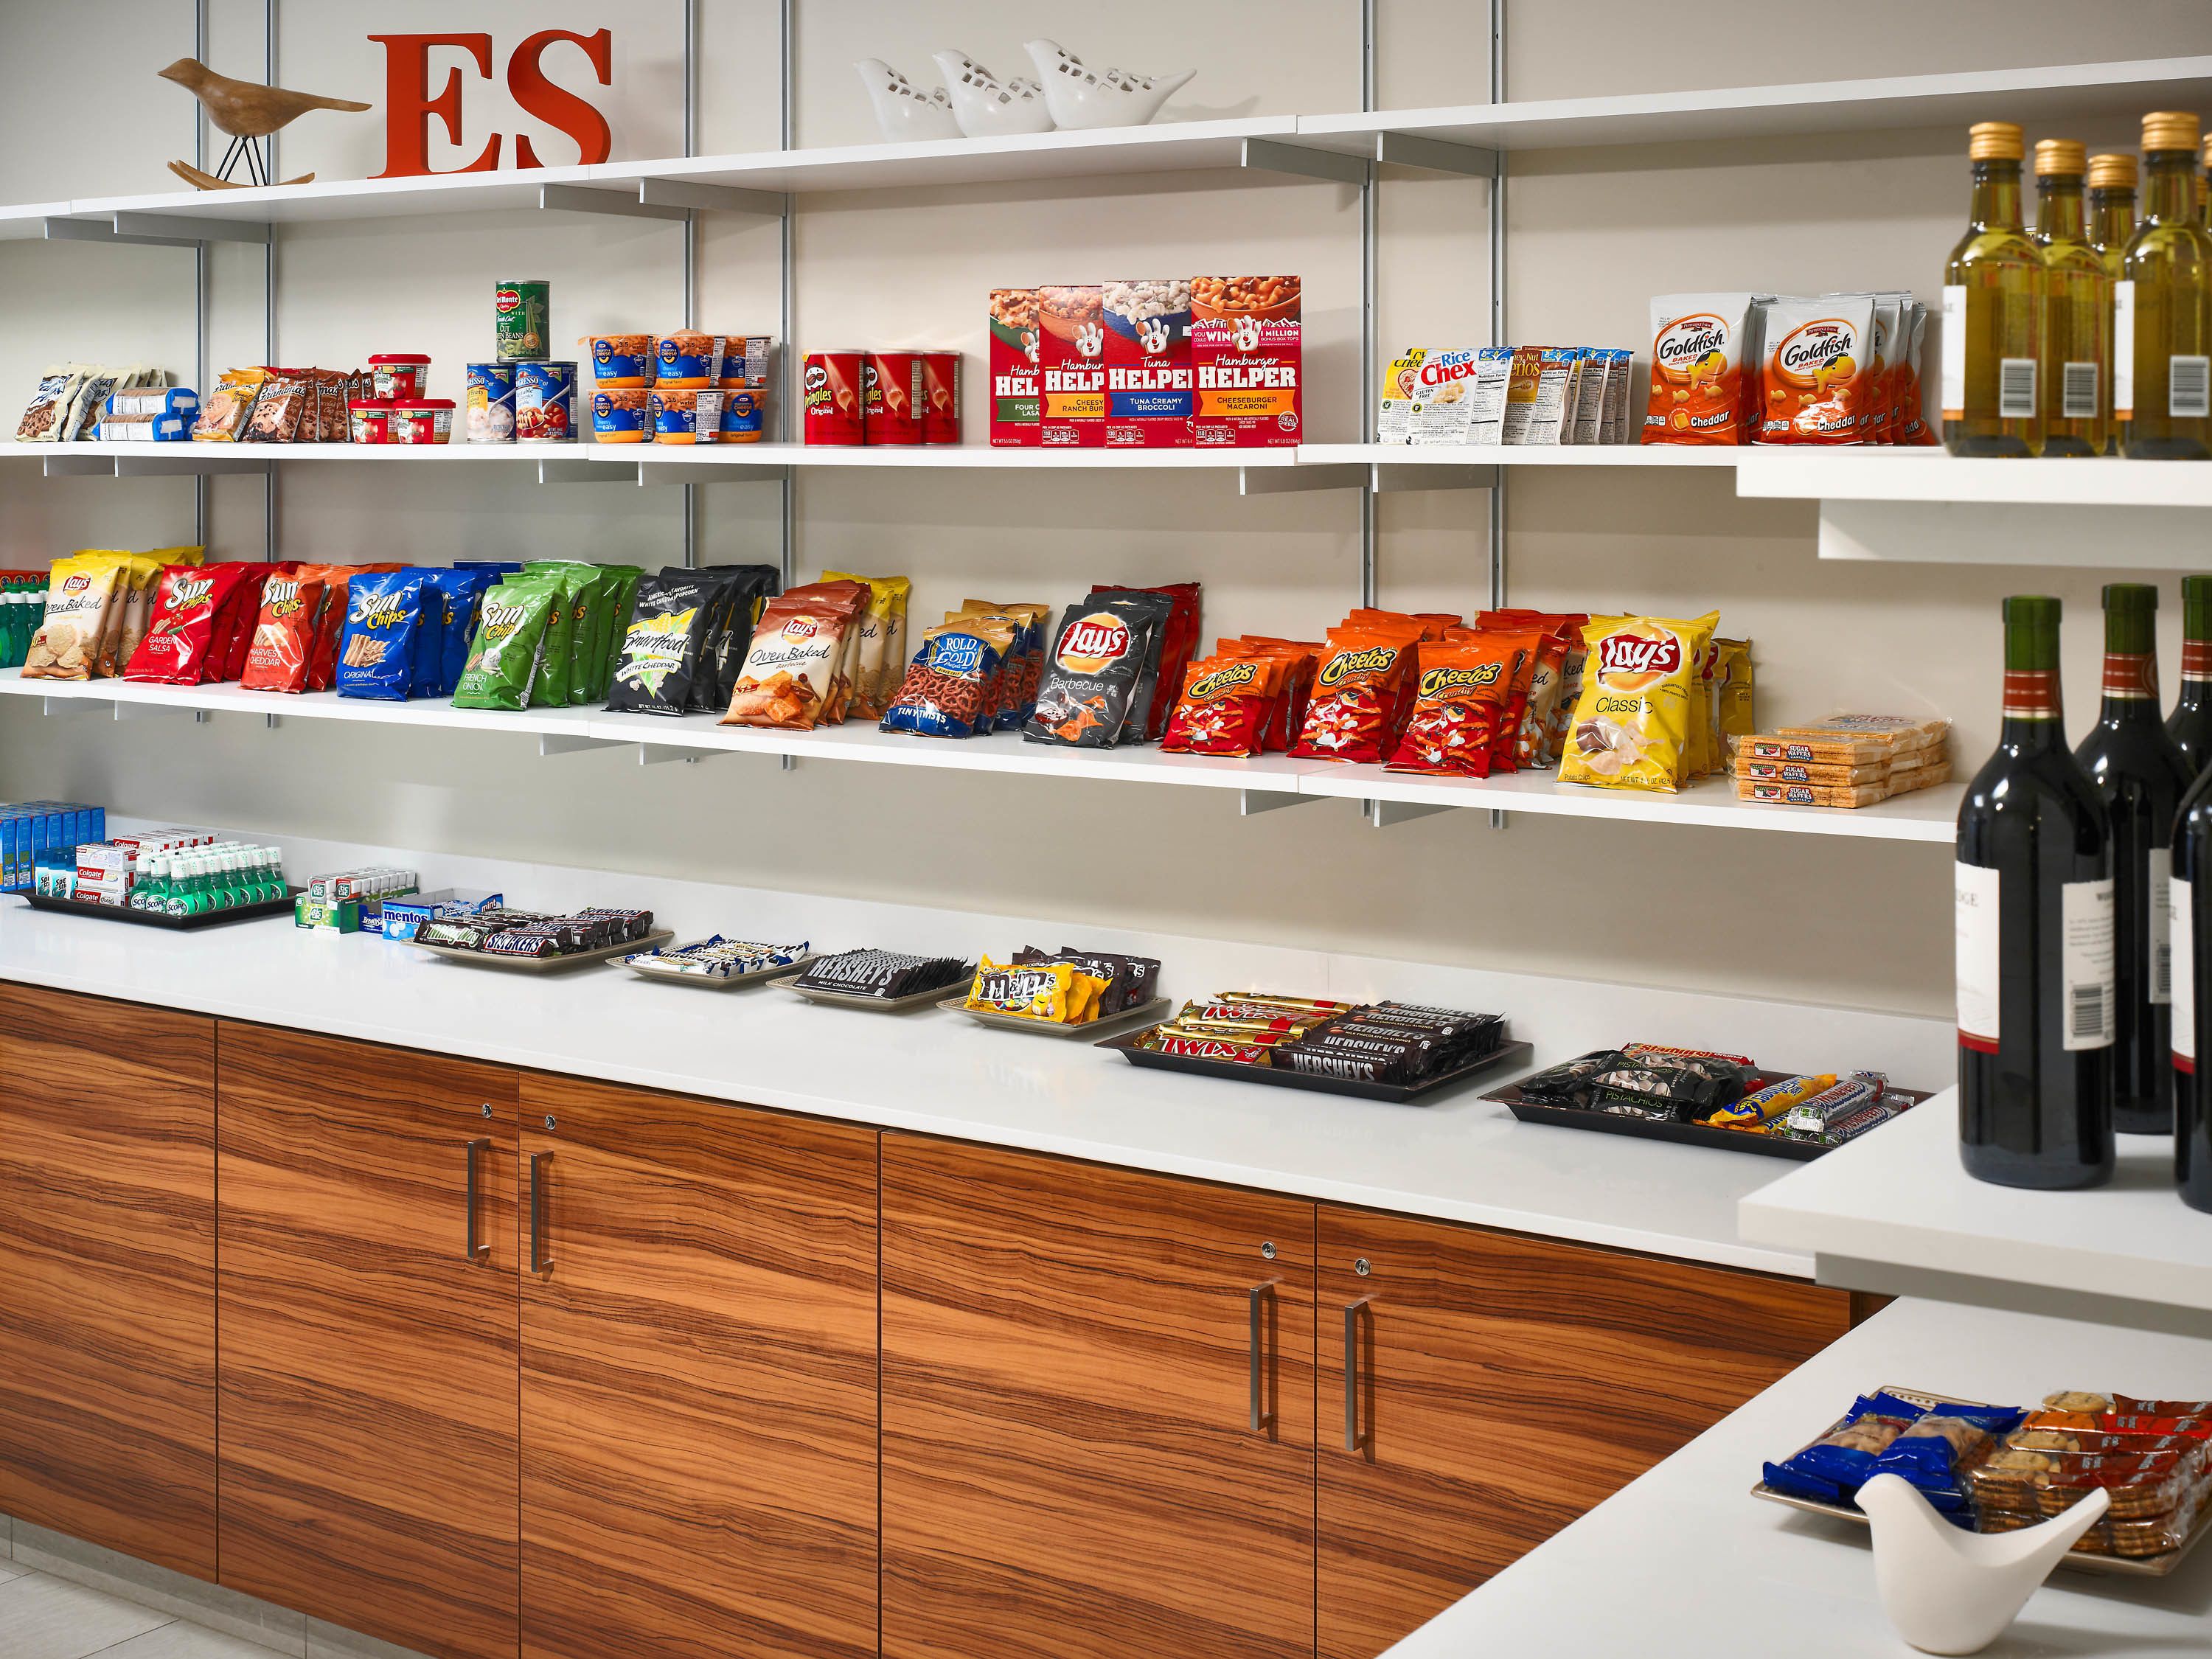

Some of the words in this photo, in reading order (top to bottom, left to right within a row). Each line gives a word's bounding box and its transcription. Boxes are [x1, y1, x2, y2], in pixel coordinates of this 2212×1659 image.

[366, 27, 611, 180] ES
[1206, 331, 1231, 341] WIN
[1660, 329, 1725, 359] Goldfish
[1526, 353, 1539, 361] Nut
[1784, 333, 1853, 366] Goldfish
[1061, 358, 1104, 370] Hambur
[1141, 356, 1171, 368] Tuna
[1216, 353, 1279, 372] Hamburger
[1441, 352, 1470, 367] Rice
[1672, 354, 1698, 363] BAKED
[1798, 358, 1824, 369] BAKED
[1011, 364, 1040, 376] Hamb
[1198, 366, 1295, 389] HELPER
[1420, 360, 1477, 386] Chex
[1510, 361, 1541, 377] erios
[995, 376, 1039, 396] HEL
[1045, 370, 1105, 391] HELP
[258, 385, 307, 402] Grandma's
[804, 387, 832, 409] Pringles
[1416, 388, 1434, 396] GLUTEN
[810, 407, 833, 416] Original
[1690, 410, 1730, 428] Cheddar
[1817, 415, 1855, 433] Cheddar
[164, 578, 216, 610] Sun
[179, 592, 213, 612] Chips
[261, 579, 299, 608] Sun
[676, 588, 698, 599] POPCORN
[46, 602, 65, 613] ven
[66, 596, 102, 610] Baked
[271, 598, 301, 618] Chips
[348, 591, 403, 624] Sun
[366, 609, 408, 630] Chips
[481, 602, 525, 630] Sun
[148, 636, 177, 644] GARDEN
[485, 624, 520, 641] Chips
[1061, 623, 1126, 658] Lay's
[148, 644, 170, 652] SALSA
[622, 630, 691, 654] Smartfood
[945, 638, 977, 652] ROLD
[251, 648, 282, 658] HARVEST
[749, 649, 788, 664] Oven
[789, 645, 831, 660] Baked
[937, 651, 977, 667] GOLD
[1599, 638, 1676, 673] Lay's
[250, 657, 280, 667] CHEDDAR
[621, 664, 641, 678] WHITE
[642, 661, 675, 669] CHEDDAR
[1321, 647, 1398, 687] Cheetos
[344, 669, 375, 678] ORIGINAL
[464, 673, 487, 683] FRENCH
[1188, 664, 1258, 698] Cheetos
[1335, 672, 1371, 688] Crunchy
[1419, 664, 1503, 698] Cheetos
[463, 683, 484, 691] ONION
[1050, 678, 1104, 692] Barbecue
[1436, 686, 1476, 700] Crunchy
[1596, 697, 1653, 714] Classic
[898, 707, 917, 717] TINY
[919, 710, 947, 723] TWISTS
[115, 841, 138, 849] Colgate
[79, 869, 102, 877] Colgate
[76, 892, 100, 901] Colgate
[481, 899, 497, 911] mint
[167, 903, 184, 912] SCOPE
[384, 911, 428, 923] mentos
[427, 924, 458, 945] Milky
[458, 928, 479, 947] Way
[485, 933, 543, 953] SNICKERS
[807, 958, 895, 986] HERSHEY'S
[832, 982, 868, 990] CHOCOLATE
[1203, 1005, 1278, 1020] TWIX
[1160, 1036, 1237, 1057] TWIX
[1291, 1052, 1374, 1081] HERSHEY'S
[1605, 1090, 1663, 1107] PISTACHIOS
